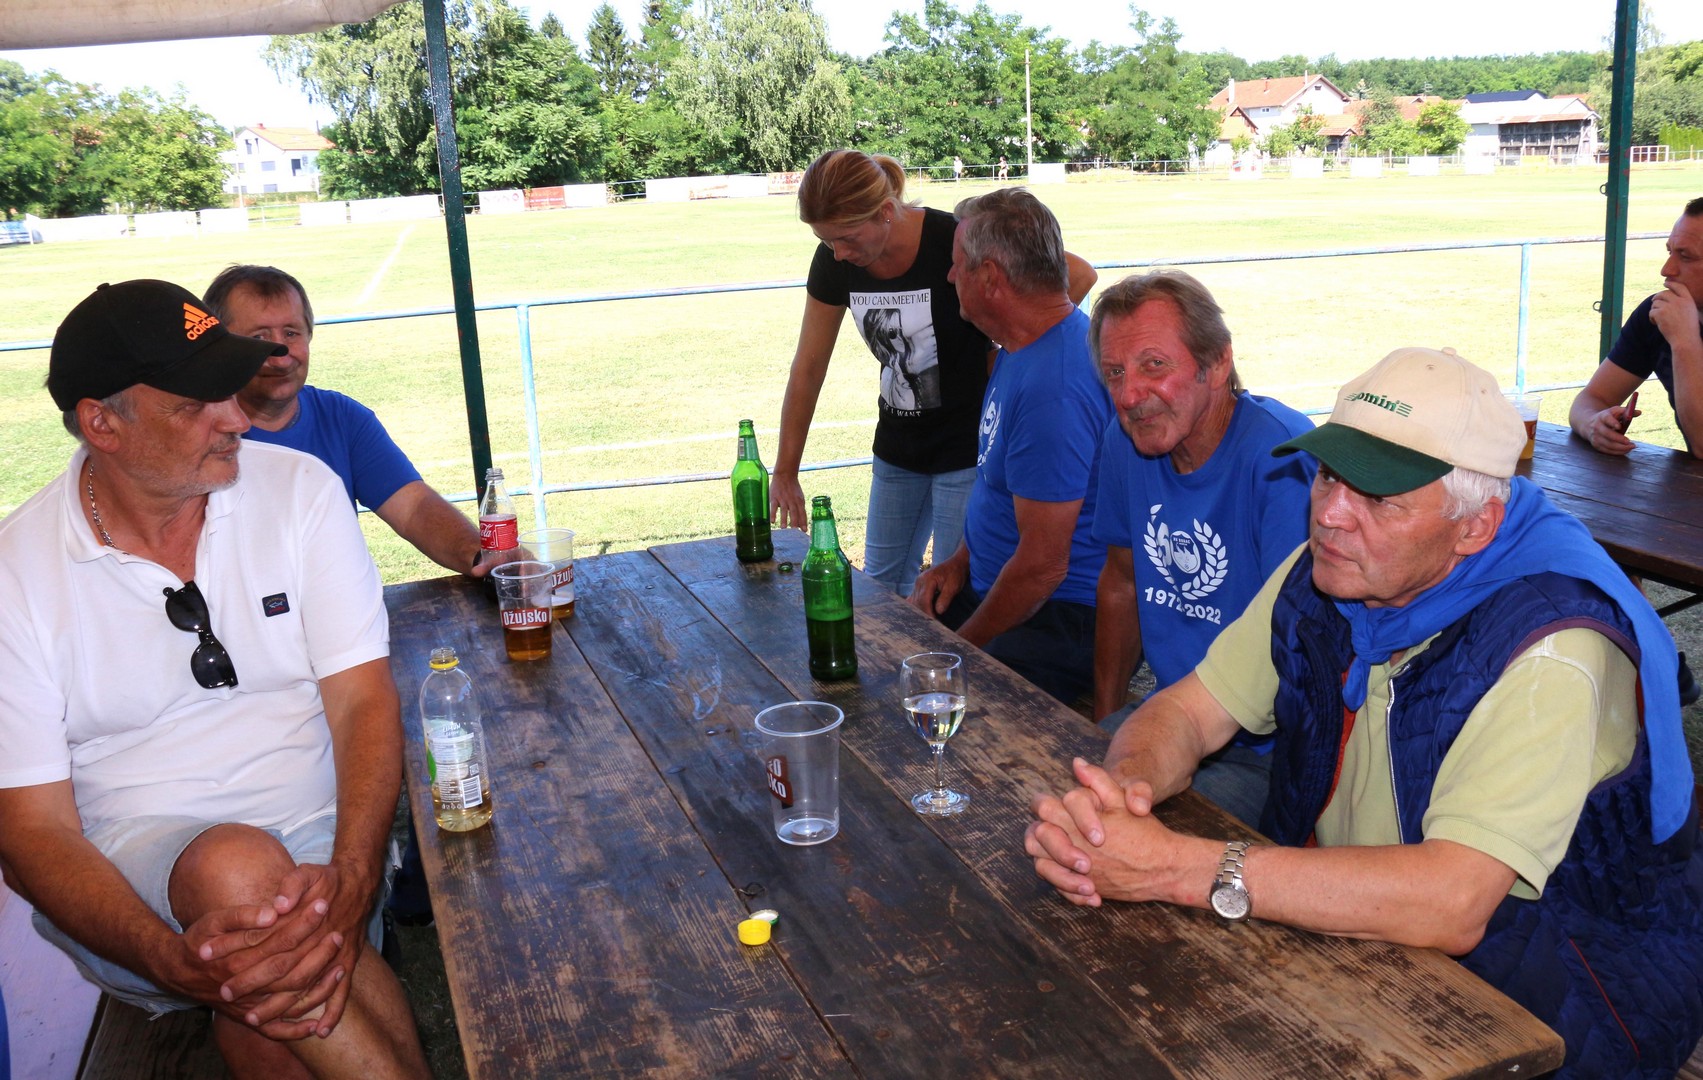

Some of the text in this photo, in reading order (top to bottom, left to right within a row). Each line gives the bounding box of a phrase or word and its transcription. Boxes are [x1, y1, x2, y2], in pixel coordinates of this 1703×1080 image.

[852, 292, 930, 306] YOU CAN MEET ME
[186, 316, 220, 340] adidas
[896, 409, 921, 417] WANT
[503, 609, 547, 626] Ožujsko
